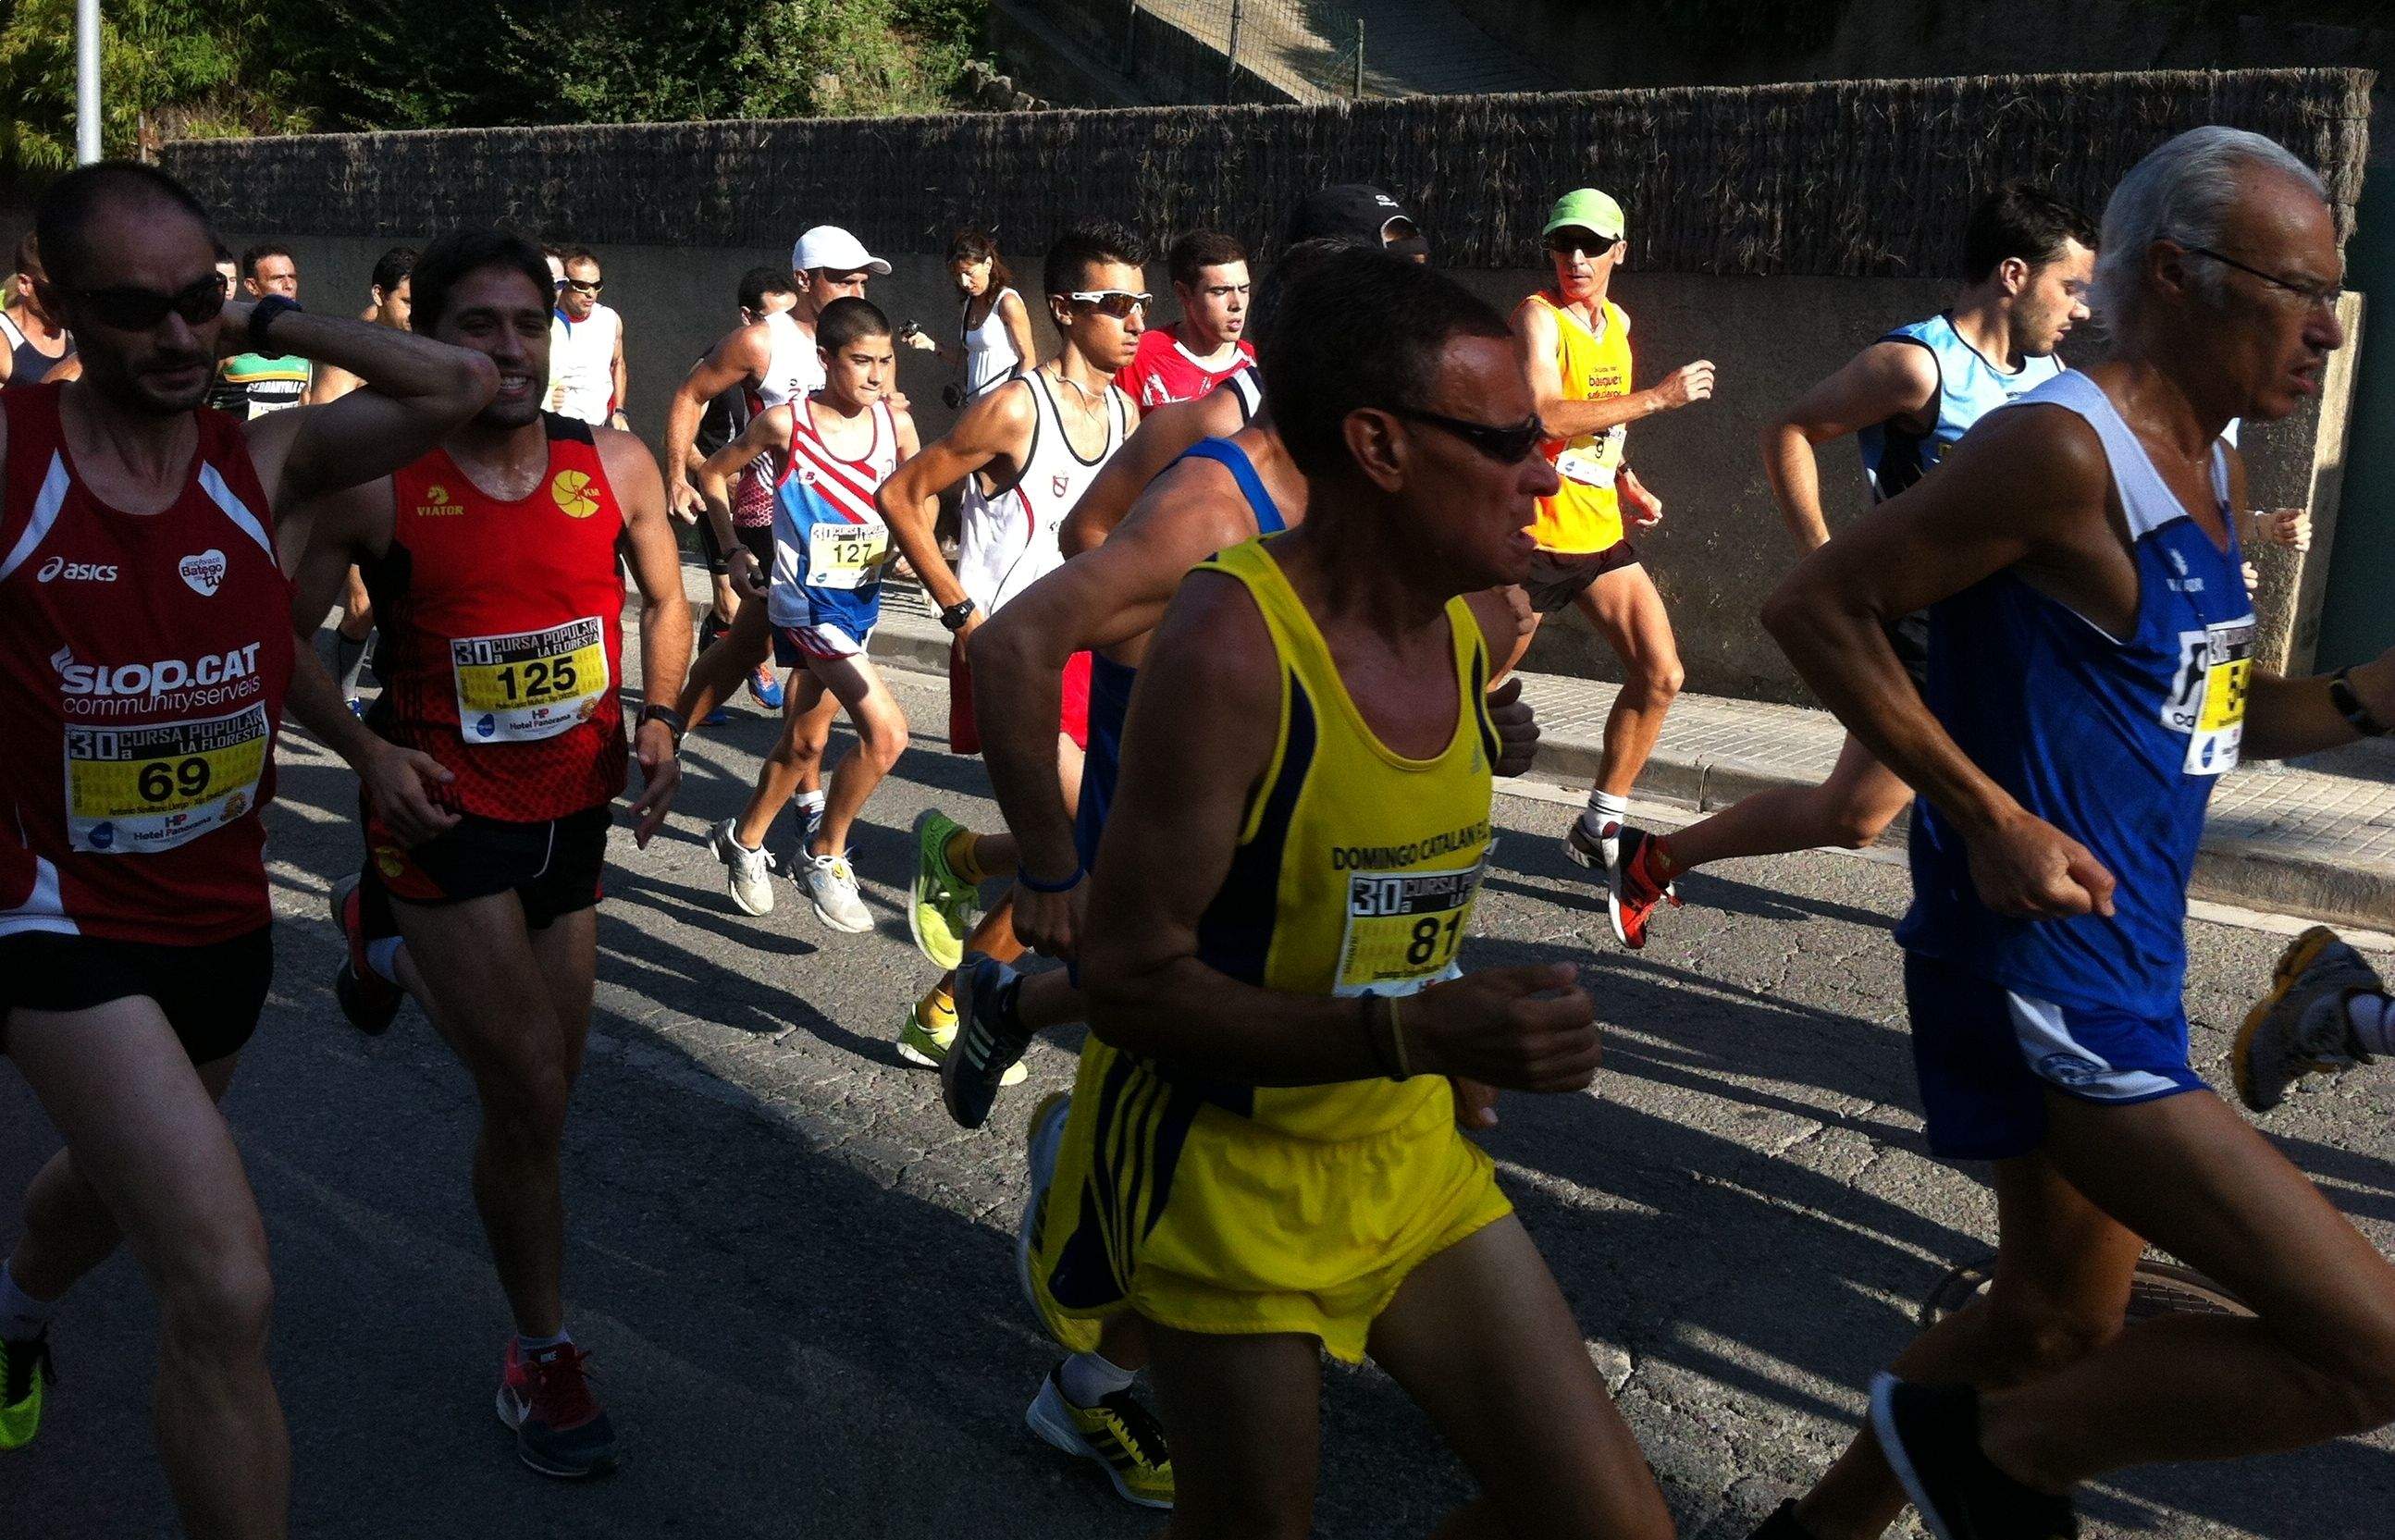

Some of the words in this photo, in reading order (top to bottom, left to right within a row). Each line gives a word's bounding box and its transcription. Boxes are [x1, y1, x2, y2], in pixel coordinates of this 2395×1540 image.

[416, 505, 464, 516] VIATOR
[833, 543, 872, 563] 127
[63, 562, 118, 582] asics
[492, 637, 539, 653] CURSA
[543, 619, 598, 646] POPULAR
[537, 647, 551, 659] LA
[554, 634, 599, 655] FLORESTA
[497, 655, 577, 700] 125
[63, 675, 262, 716] communityserveis
[119, 727, 183, 747] CURSA
[189, 709, 264, 739] POPULAR
[510, 721, 532, 731] Hotel
[533, 713, 571, 727] Panorama
[179, 741, 198, 755] LA
[202, 725, 266, 751] FLORESTA
[139, 757, 211, 803] 69
[133, 830, 164, 841] Hotel
[165, 816, 212, 839] Panorama
[1332, 843, 1418, 870] DOMINGO
[1407, 910, 1463, 966] 81
